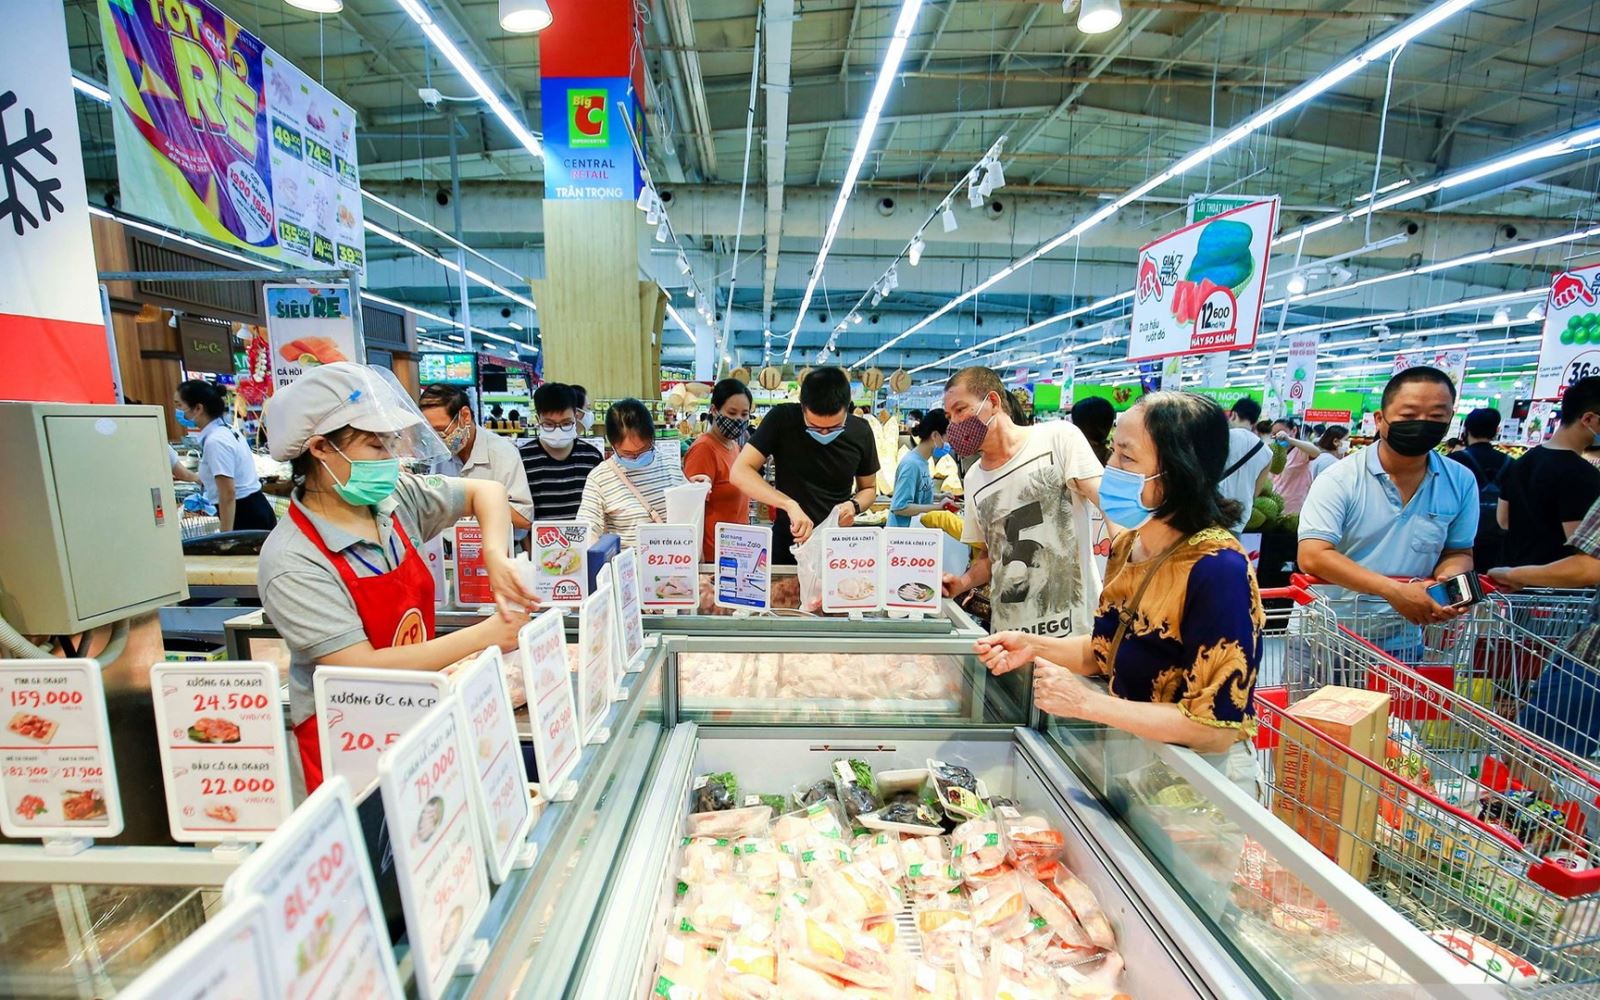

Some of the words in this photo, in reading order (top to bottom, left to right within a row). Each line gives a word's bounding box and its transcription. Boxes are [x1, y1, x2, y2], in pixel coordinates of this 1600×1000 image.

[573, 95, 592, 109] Big
[575, 95, 606, 136] C
[563, 159, 616, 169] CENTRAL
[571, 170, 609, 180] RETAIL
[276, 298, 310, 319] SIÊU
[312, 288, 342, 318] RẺ
[1201, 301, 1213, 329] 12
[1213, 306, 1230, 319] 600
[1205, 336, 1215, 345] SO
[277, 366, 287, 376] CÁ
[747, 540, 762, 549] Zalo
[1001, 501, 1044, 604] 5
[648, 553, 692, 565] 82.700
[829, 558, 876, 571] 68.900
[890, 556, 936, 568] 85.000
[556, 585, 567, 594] 79
[11, 689, 84, 709] 159.000
[193, 692, 269, 712] 24.500
[418, 697, 437, 708] CP
[8, 766, 49, 777] 82.900
[62, 766, 104, 778] 27.900
[201, 778, 275, 795] 22.000
